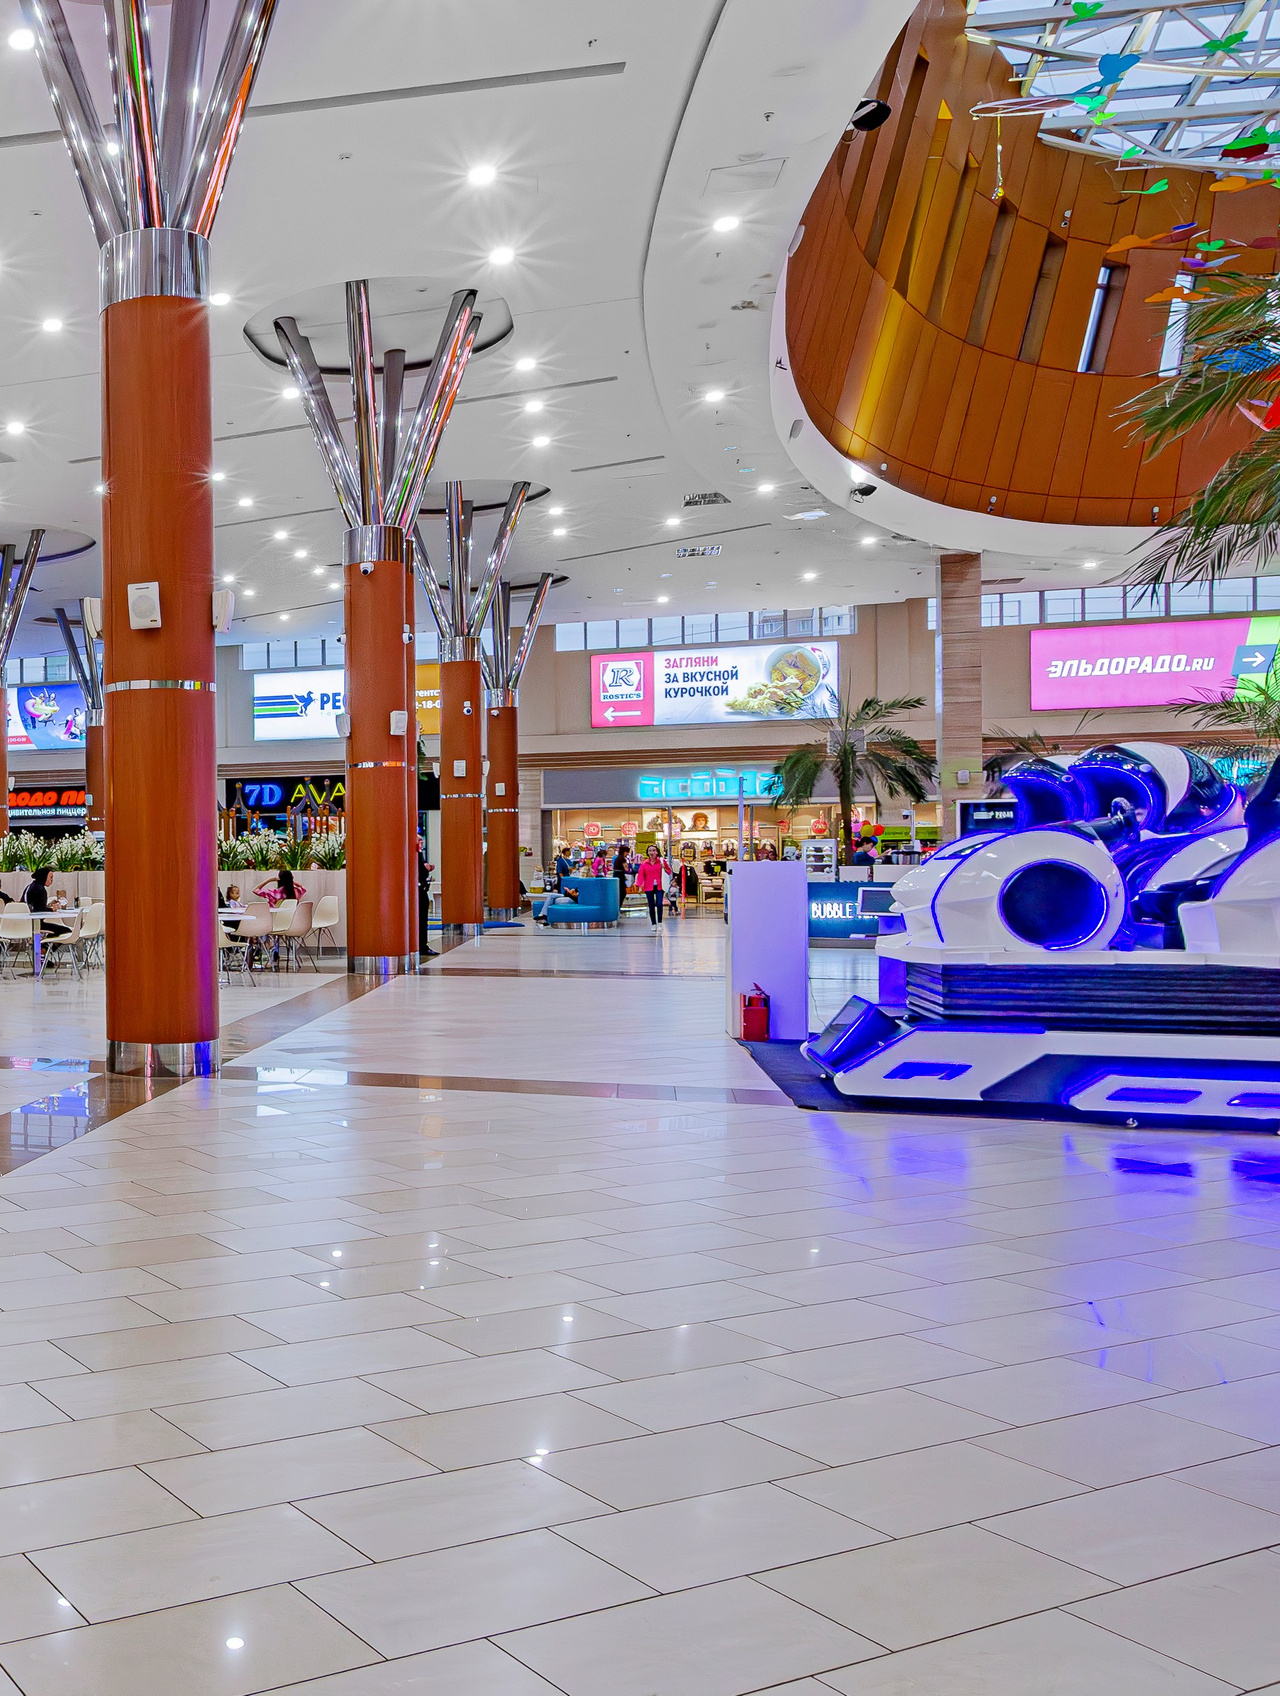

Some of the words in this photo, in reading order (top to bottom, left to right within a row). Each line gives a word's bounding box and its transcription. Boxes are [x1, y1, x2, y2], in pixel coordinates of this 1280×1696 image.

[664, 655, 719, 669] ЗАГЛЯНИ
[1047, 654, 1215, 678] ЭЛЬДОРАДО.RU
[609, 667, 634, 687] R
[664, 672, 679, 684] ЗА
[683, 666, 739, 683] ВКУСНОЙ
[602, 692, 642, 701] ROSTIC'S
[664, 682, 729, 699] КУРОЧКОЙ
[245, 784, 282, 806] 7D
[811, 902, 854, 918] BUBBLE
